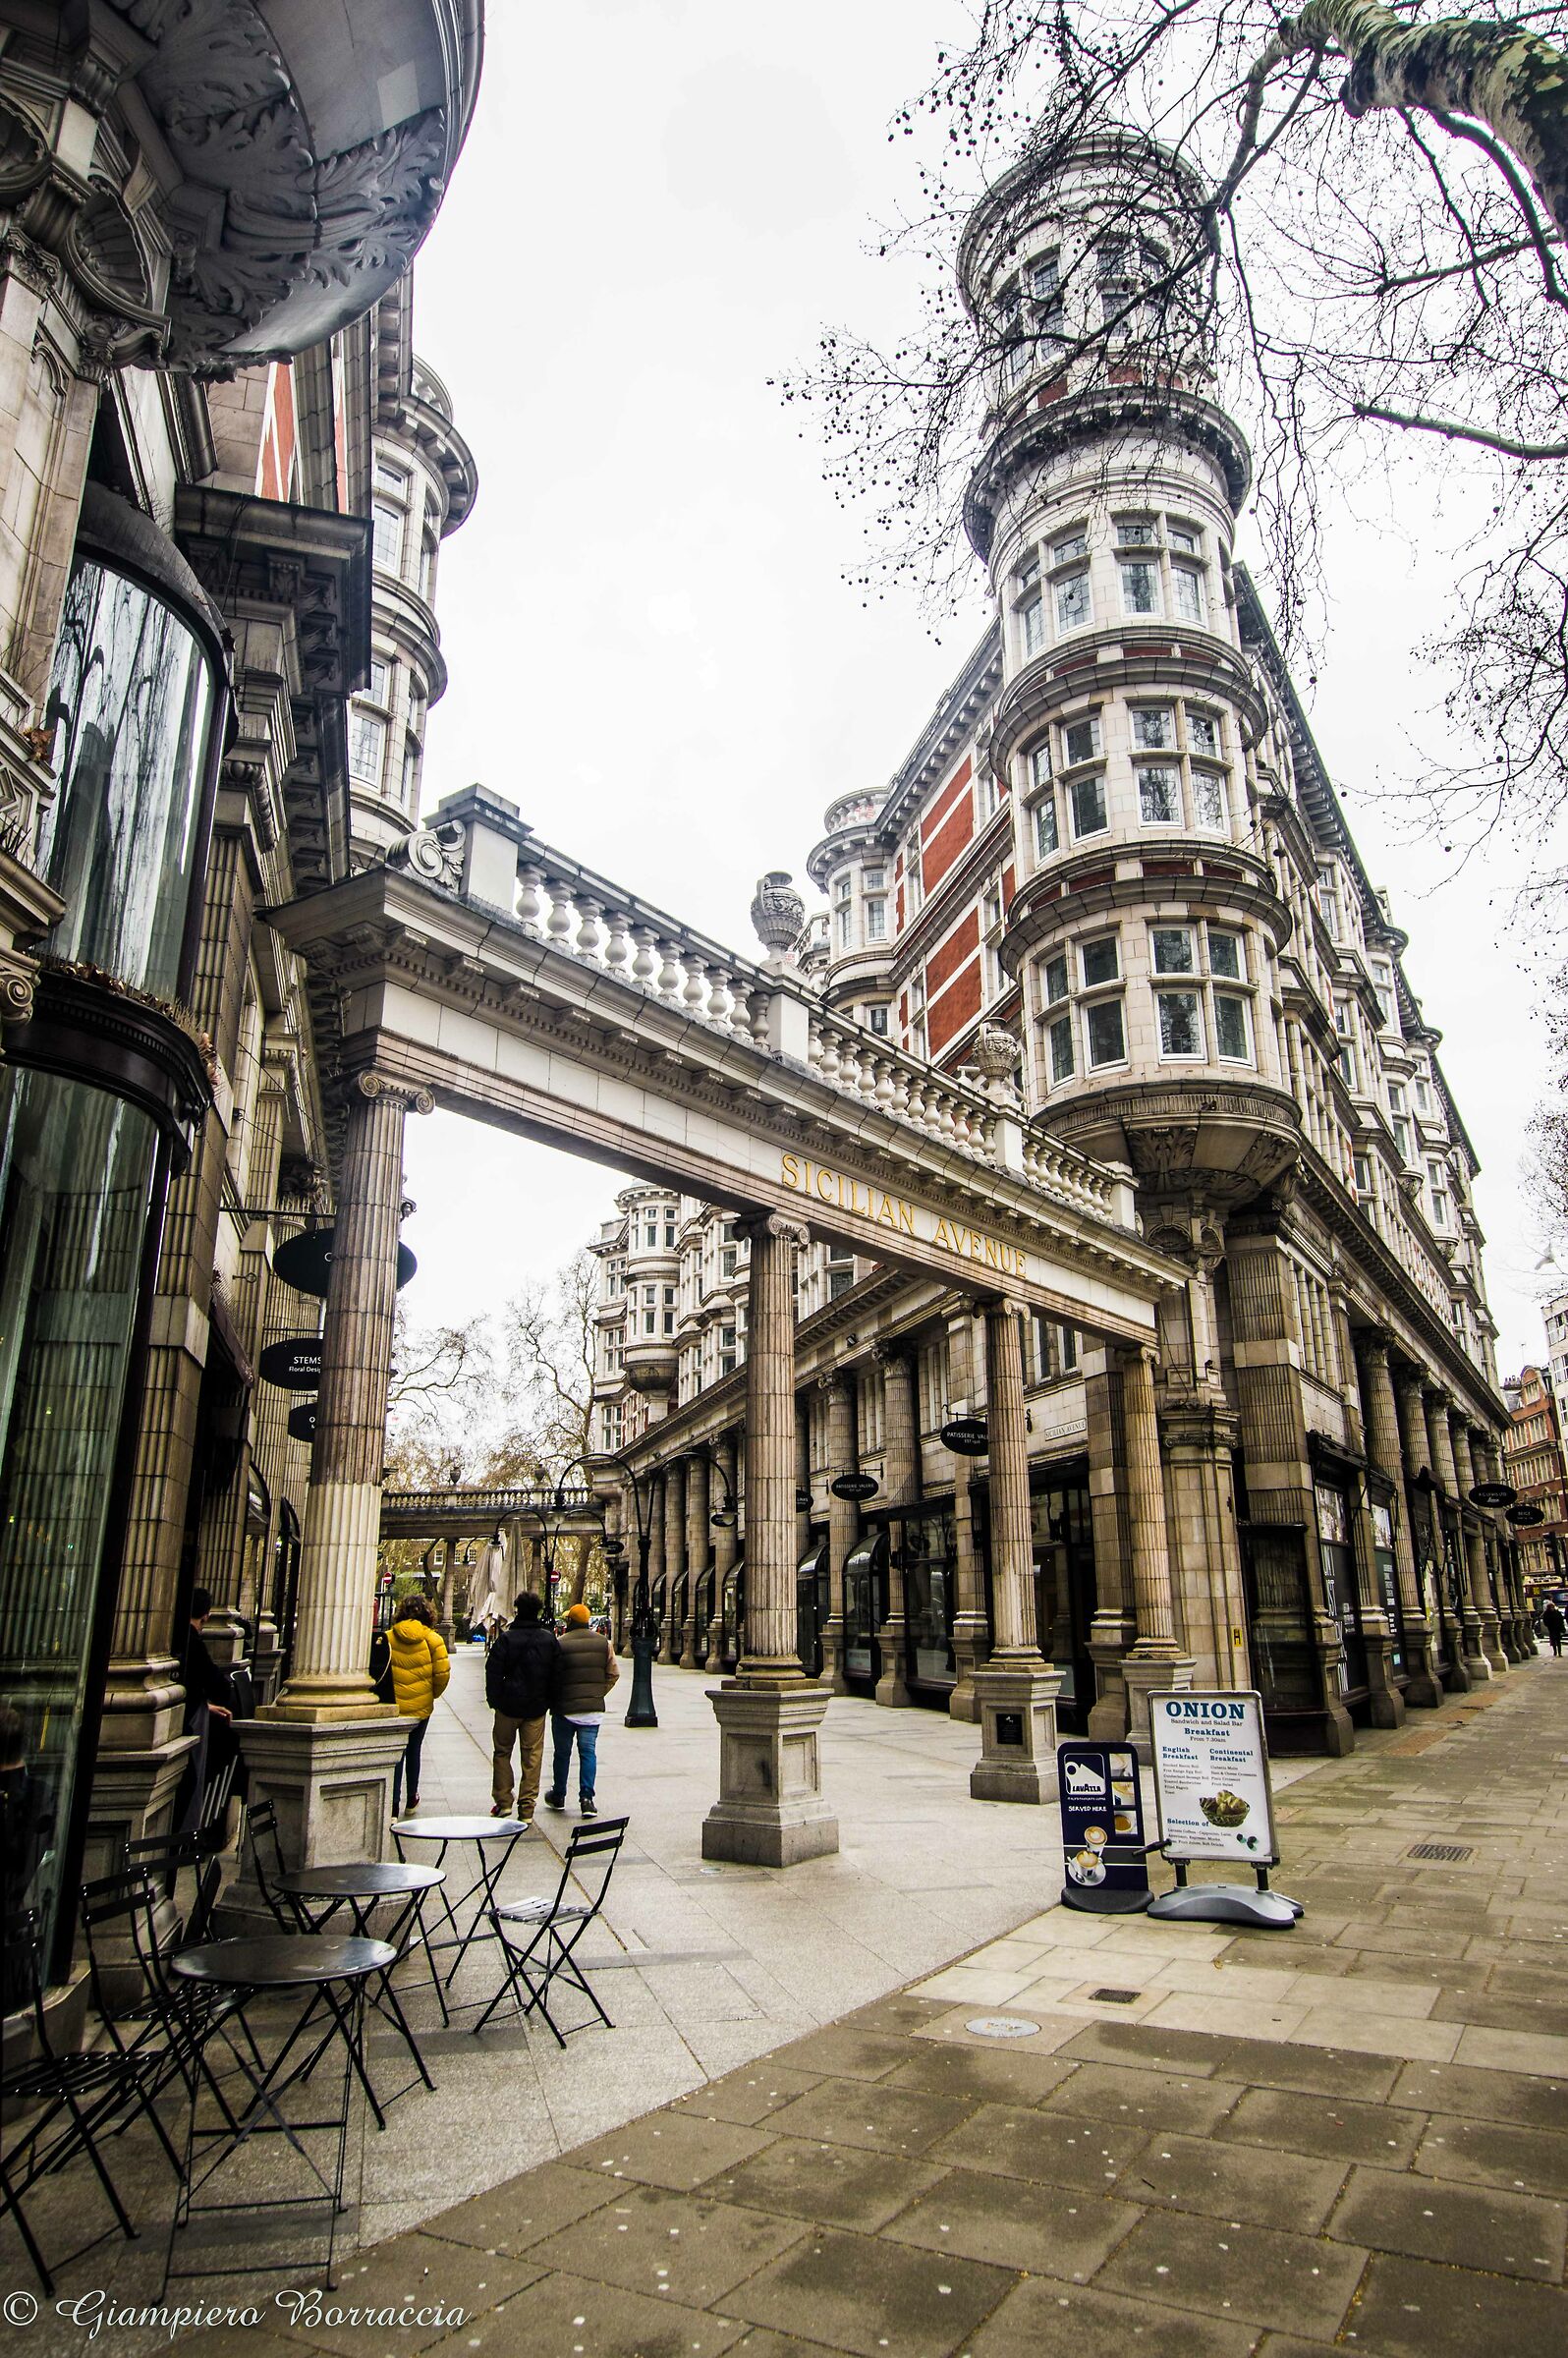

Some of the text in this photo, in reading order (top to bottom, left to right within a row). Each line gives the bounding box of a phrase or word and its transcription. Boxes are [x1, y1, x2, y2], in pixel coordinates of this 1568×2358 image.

[781, 1153, 1027, 1278] SICILIAN AVENUE
[1234, 1629, 1241, 1645] H
[1166, 1702, 1245, 1718] ONION
